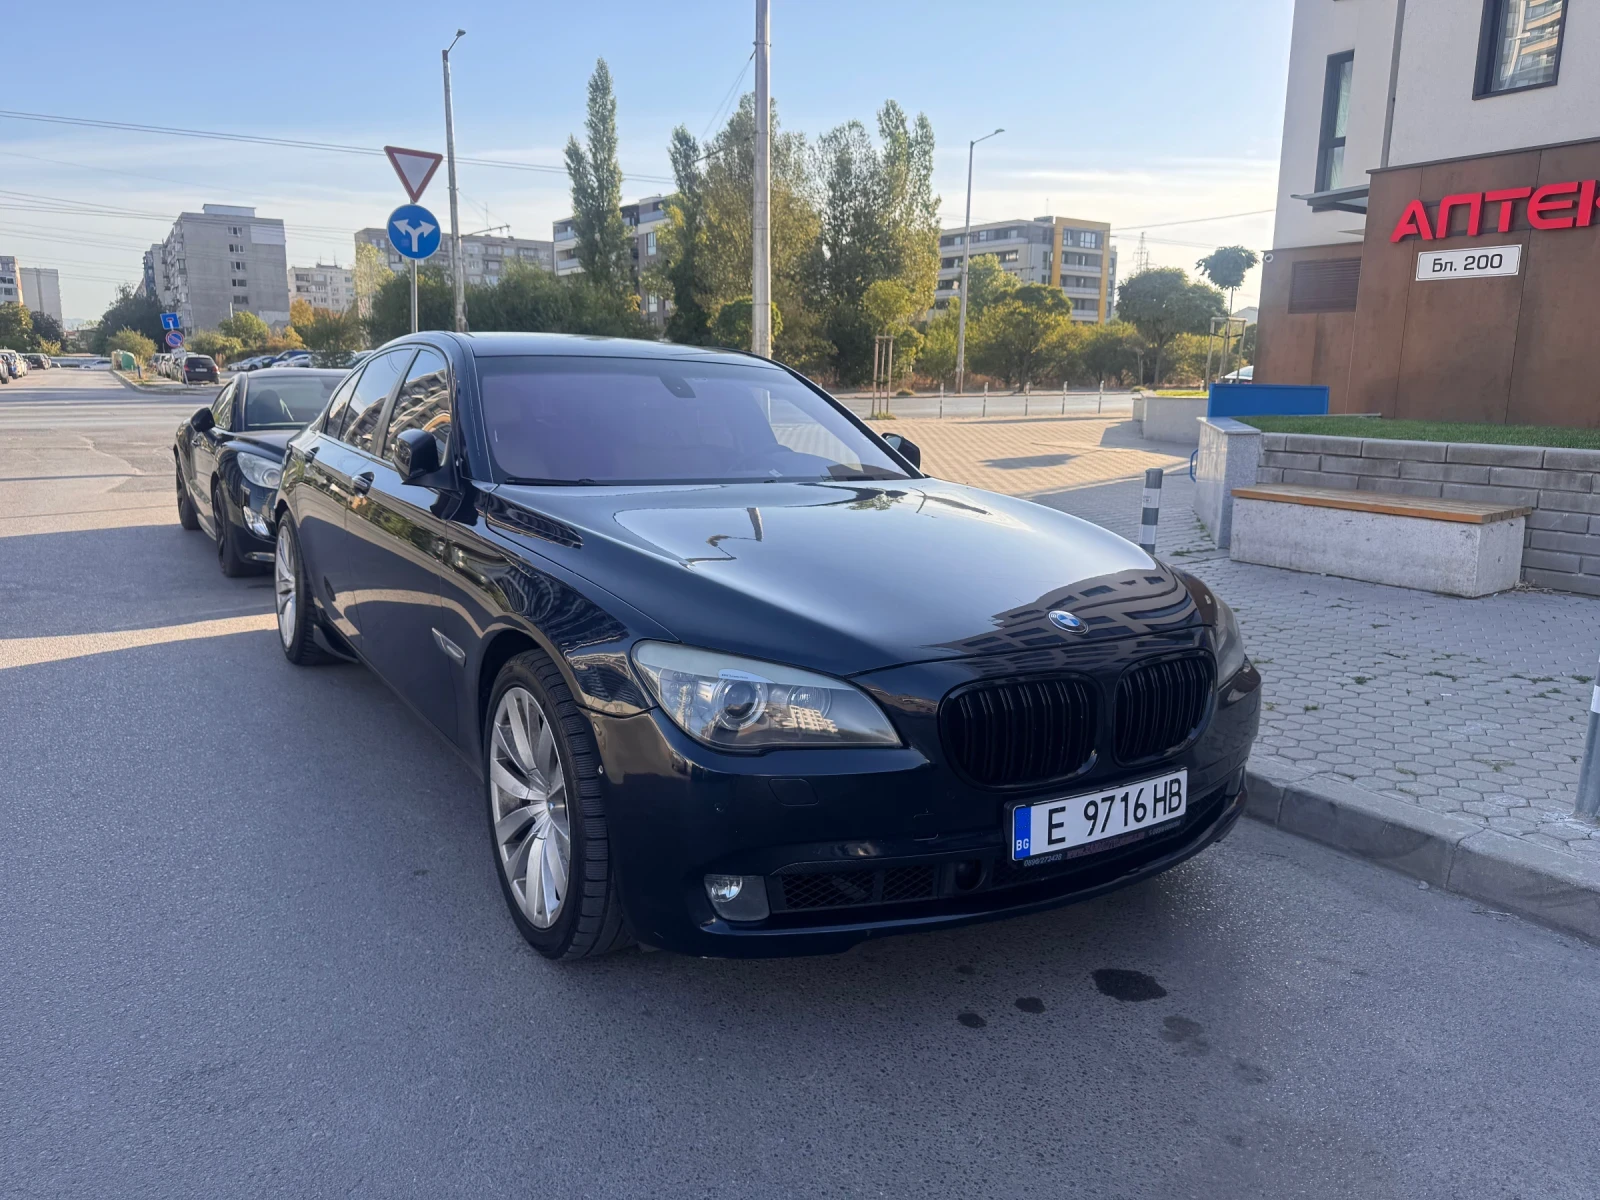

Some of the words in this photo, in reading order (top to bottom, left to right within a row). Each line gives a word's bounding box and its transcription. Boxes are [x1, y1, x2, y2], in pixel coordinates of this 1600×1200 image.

[1432, 257, 1457, 273] Бл.
[1463, 253, 1504, 271] 200
[1047, 806, 1067, 846] E
[1016, 838, 1030, 851] BG
